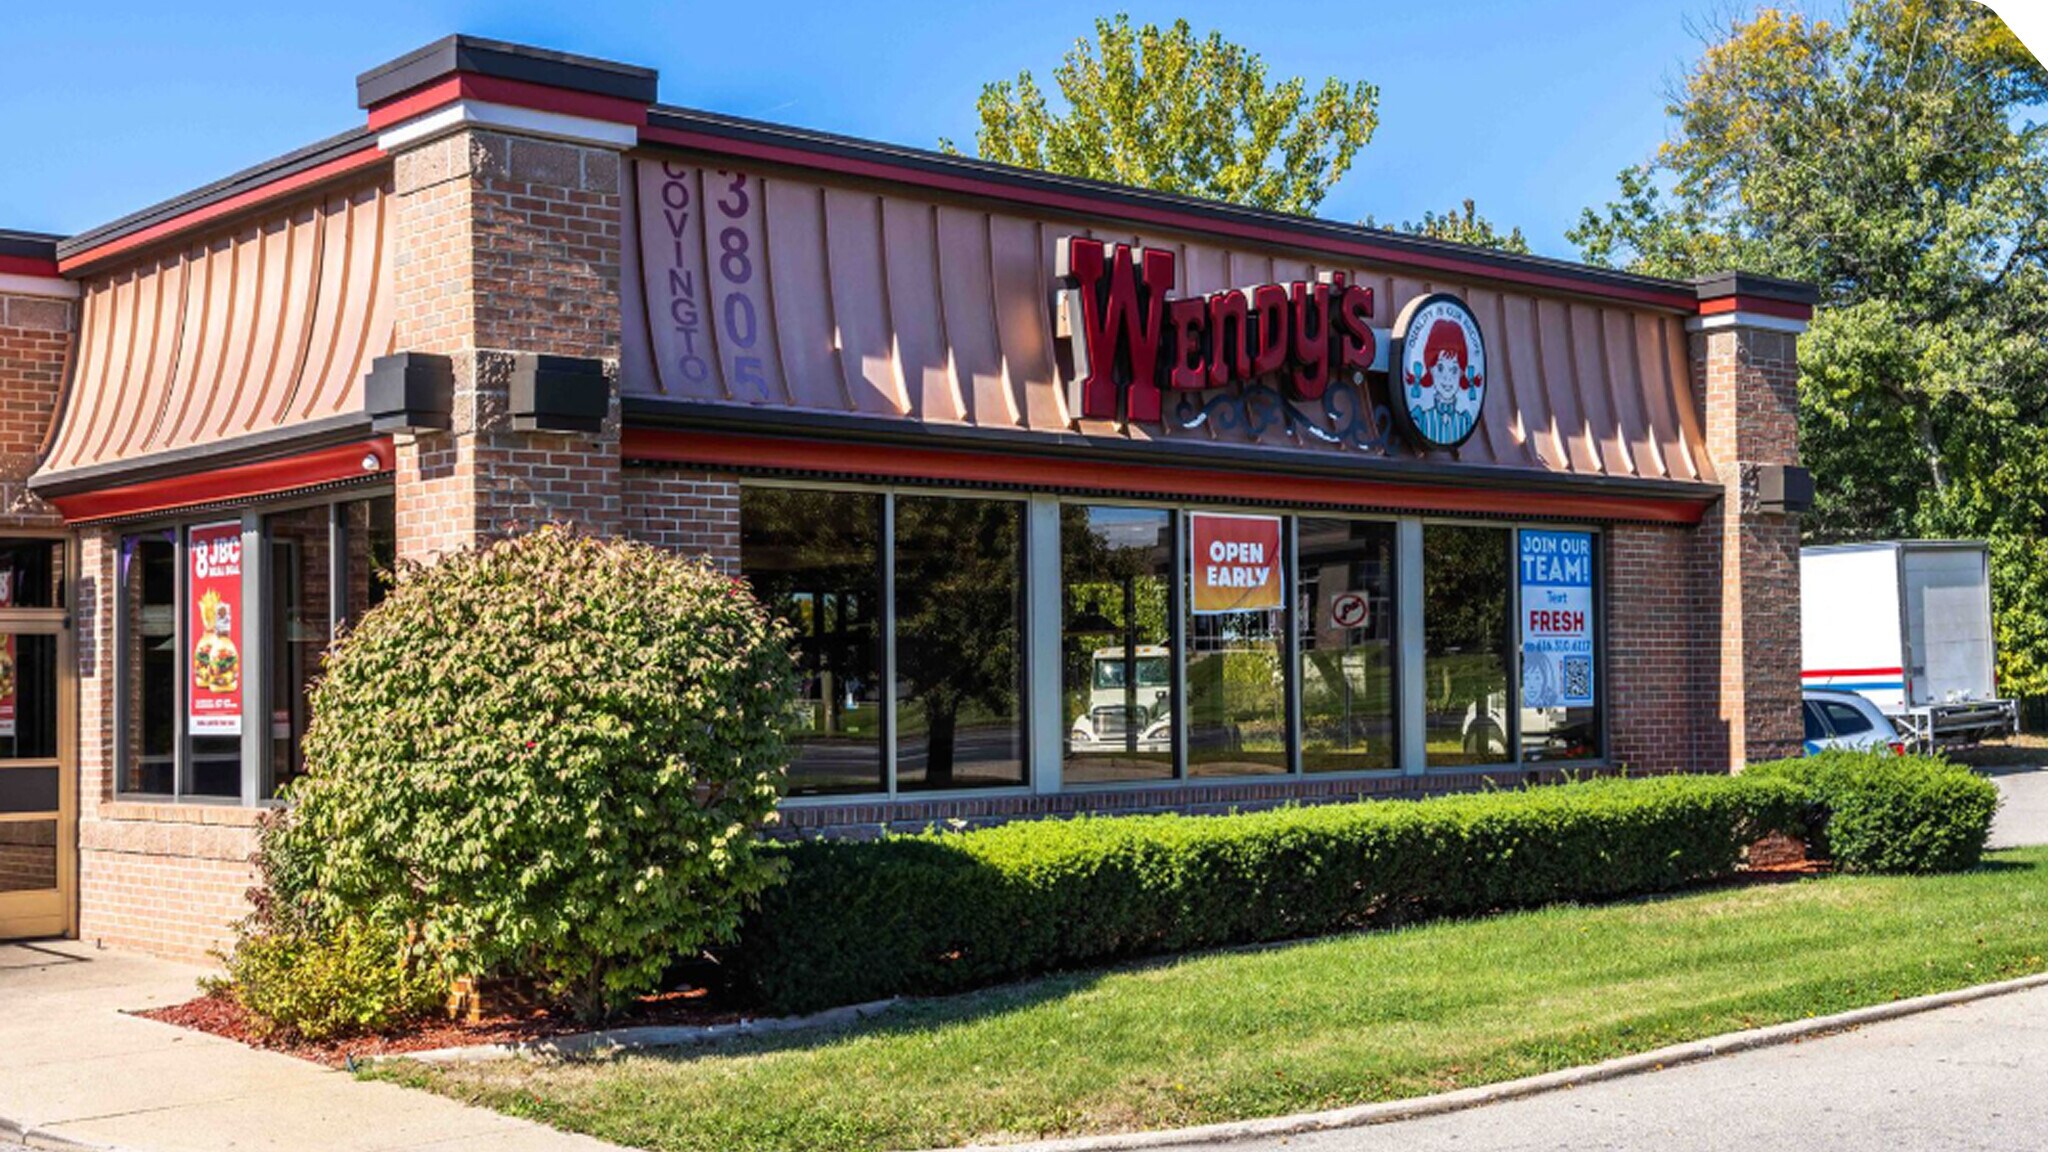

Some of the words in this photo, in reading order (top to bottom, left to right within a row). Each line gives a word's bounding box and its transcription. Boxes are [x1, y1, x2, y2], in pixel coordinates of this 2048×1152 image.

[1069, 236, 1377, 423] Wendy's
[1209, 540, 1264, 564] OPEN
[1523, 536, 1557, 553] JOIN
[1561, 538, 1589, 555] OUR
[1206, 565, 1270, 588] EARLY
[1523, 555, 1589, 583] TEAM!
[1530, 610, 1585, 632] FRESH
